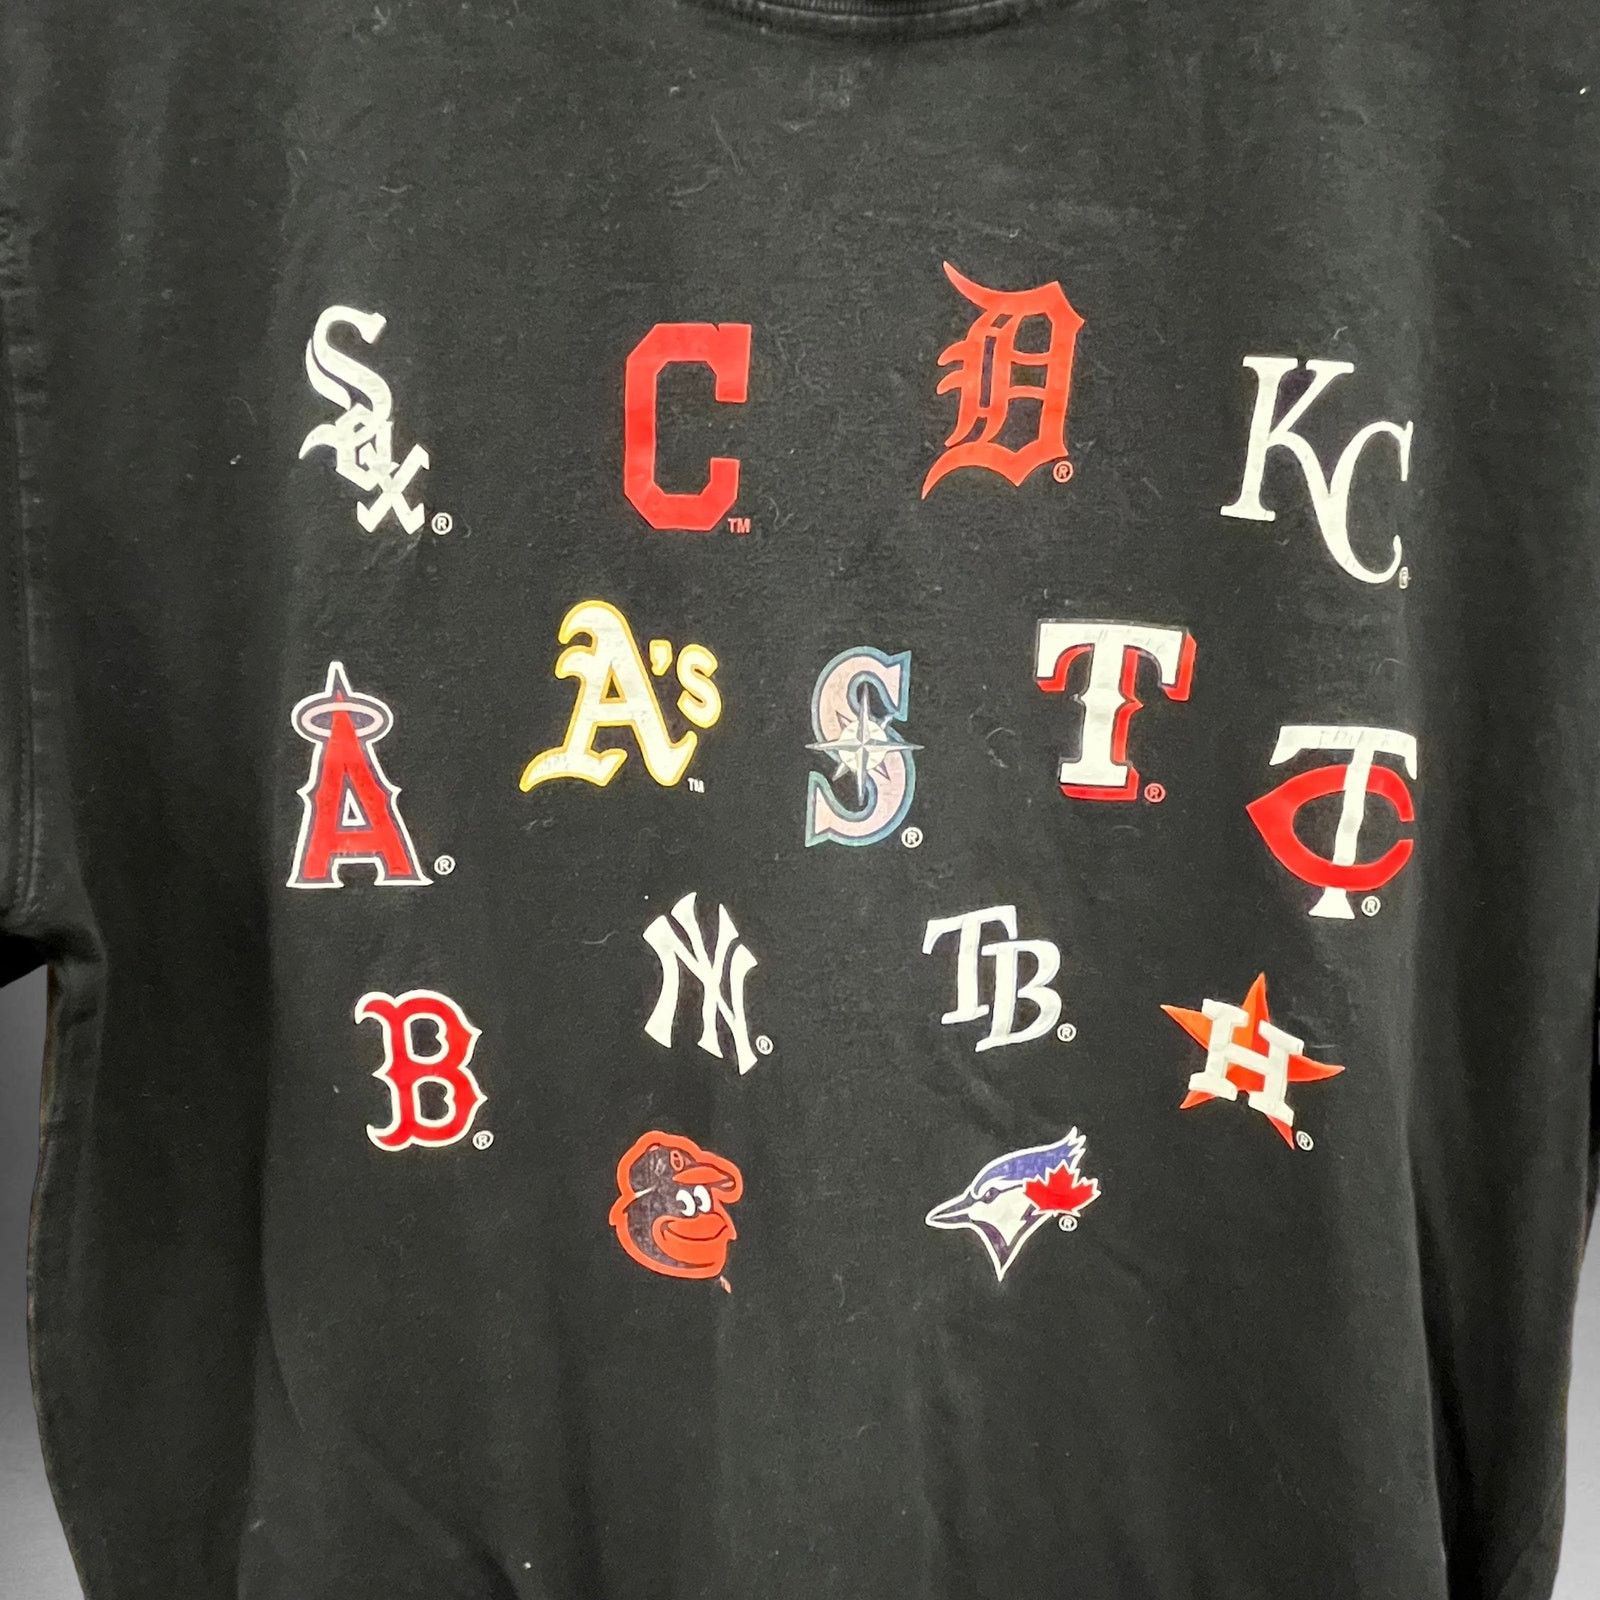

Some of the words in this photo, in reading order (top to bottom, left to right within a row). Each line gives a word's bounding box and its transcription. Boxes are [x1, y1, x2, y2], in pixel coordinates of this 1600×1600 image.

[623, 322, 753, 533] C
[921, 261, 1085, 500] D
[1220, 355, 1414, 589] KC
[286, 661, 432, 890] A
[519, 599, 724, 792] A's
[804, 645, 916, 848] S
[1034, 618, 1197, 802] T
[354, 989, 488, 1152] B
[643, 892, 758, 1075] NY
[922, 905, 1062, 1052] TB
[1188, 998, 1305, 1127] H
